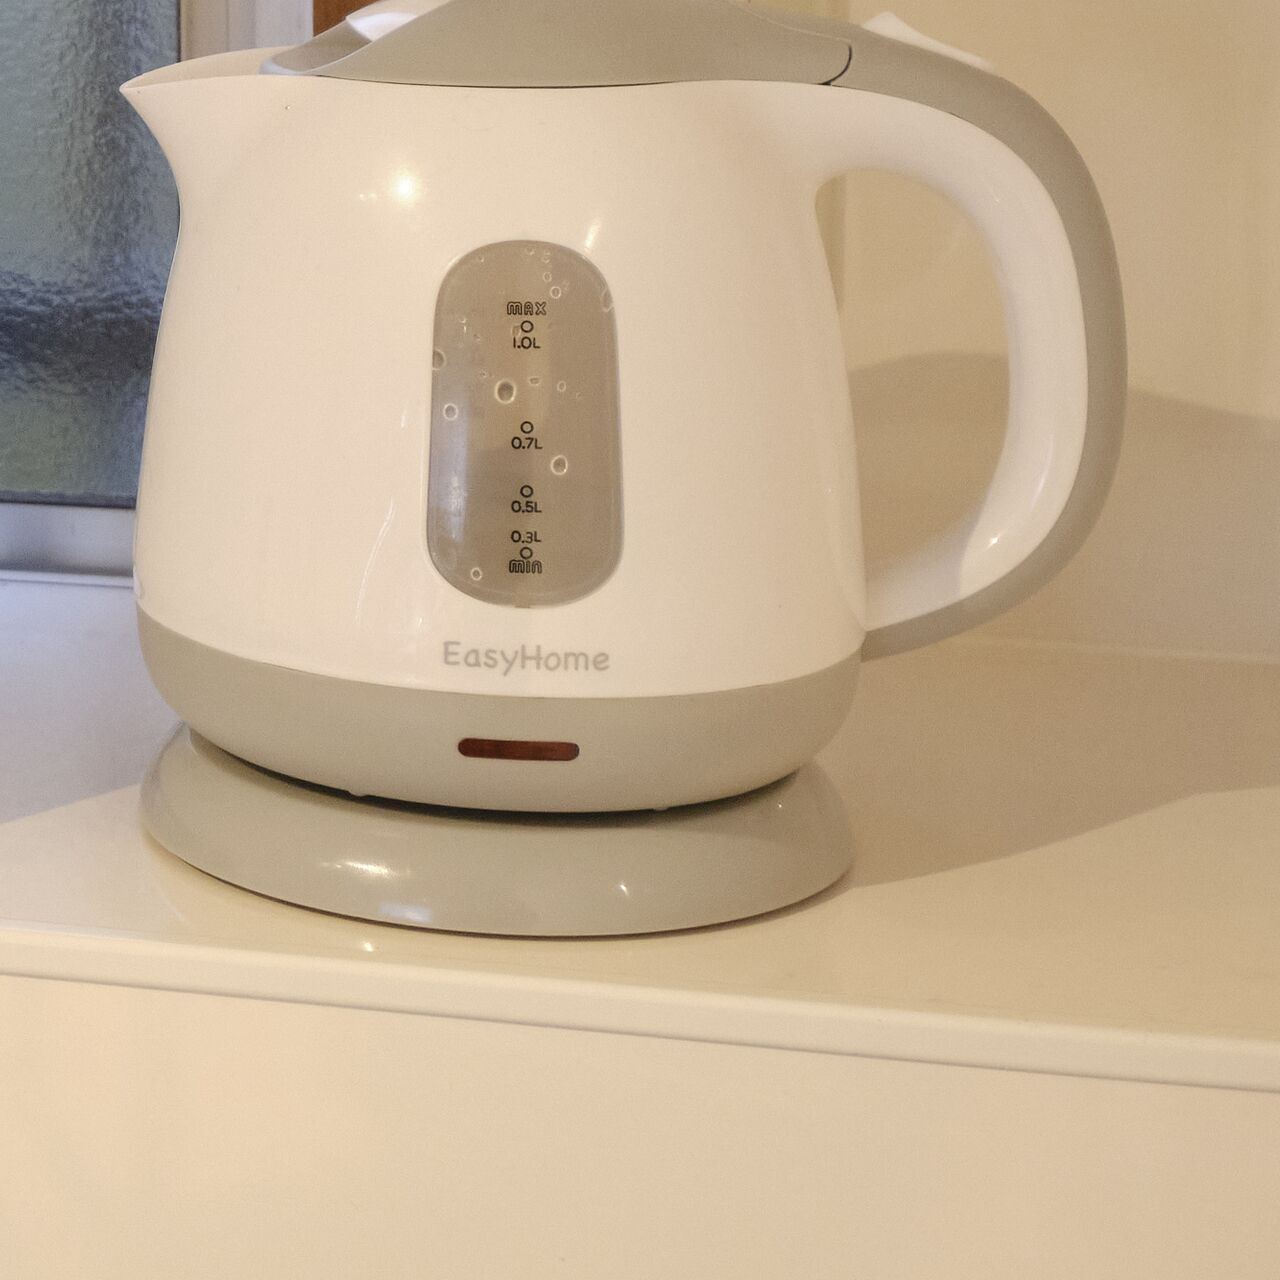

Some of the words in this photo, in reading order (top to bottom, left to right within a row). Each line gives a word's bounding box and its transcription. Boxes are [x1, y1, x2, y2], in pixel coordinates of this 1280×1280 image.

[512, 337, 541, 350] 1.0L
[511, 437, 542, 450] 0.7L
[511, 500, 542, 514] 0.5L
[511, 530, 542, 544] 0.3L
[442, 640, 611, 675] EasyHome
